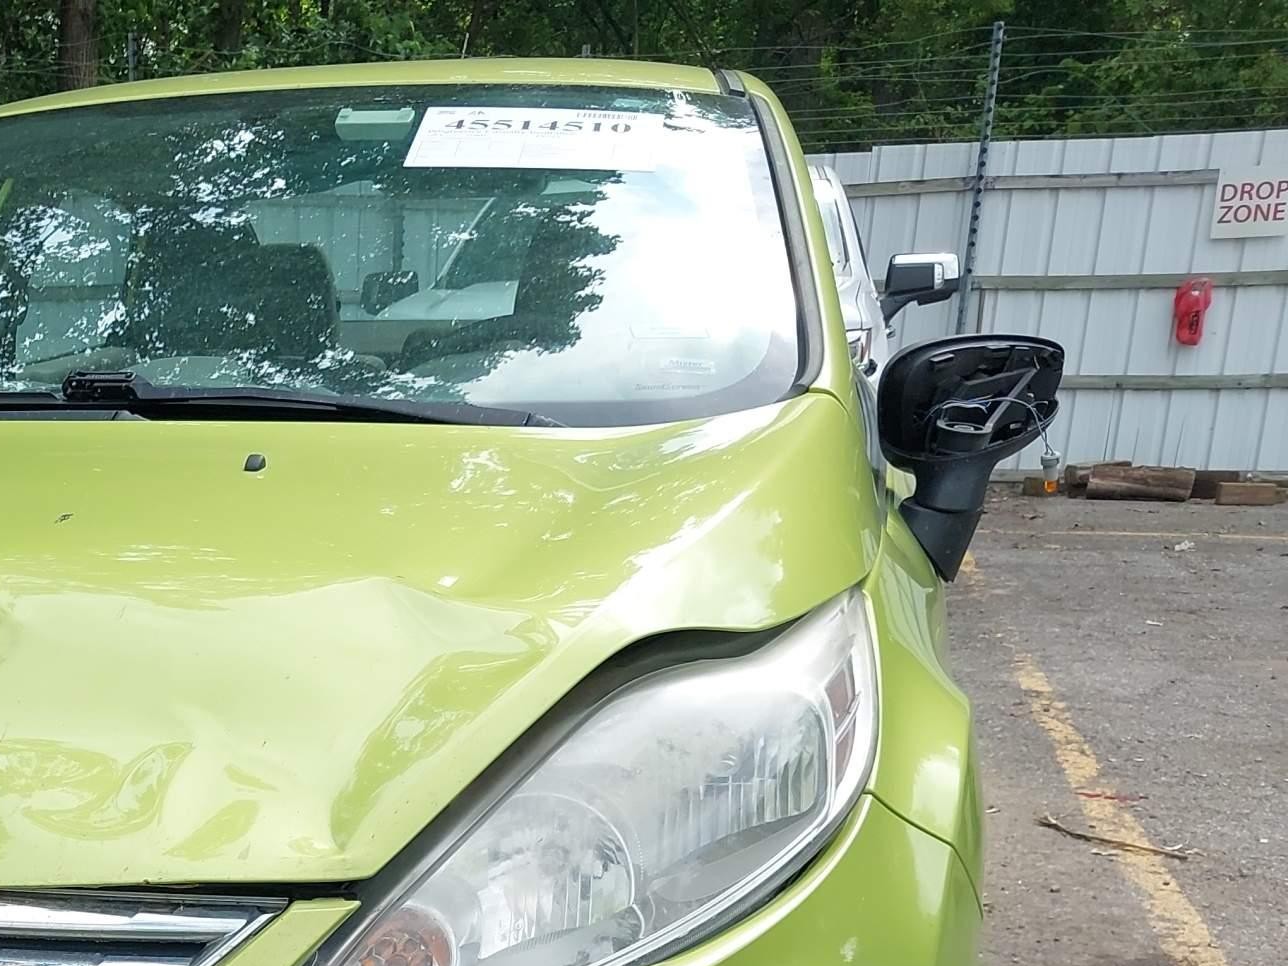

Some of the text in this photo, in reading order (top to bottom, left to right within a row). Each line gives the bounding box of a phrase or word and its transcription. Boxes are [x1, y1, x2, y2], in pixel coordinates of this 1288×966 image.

[444, 119, 631, 133] 45514510
[1220, 180, 1288, 202] DROP
[1217, 202, 1286, 224] ZONE
